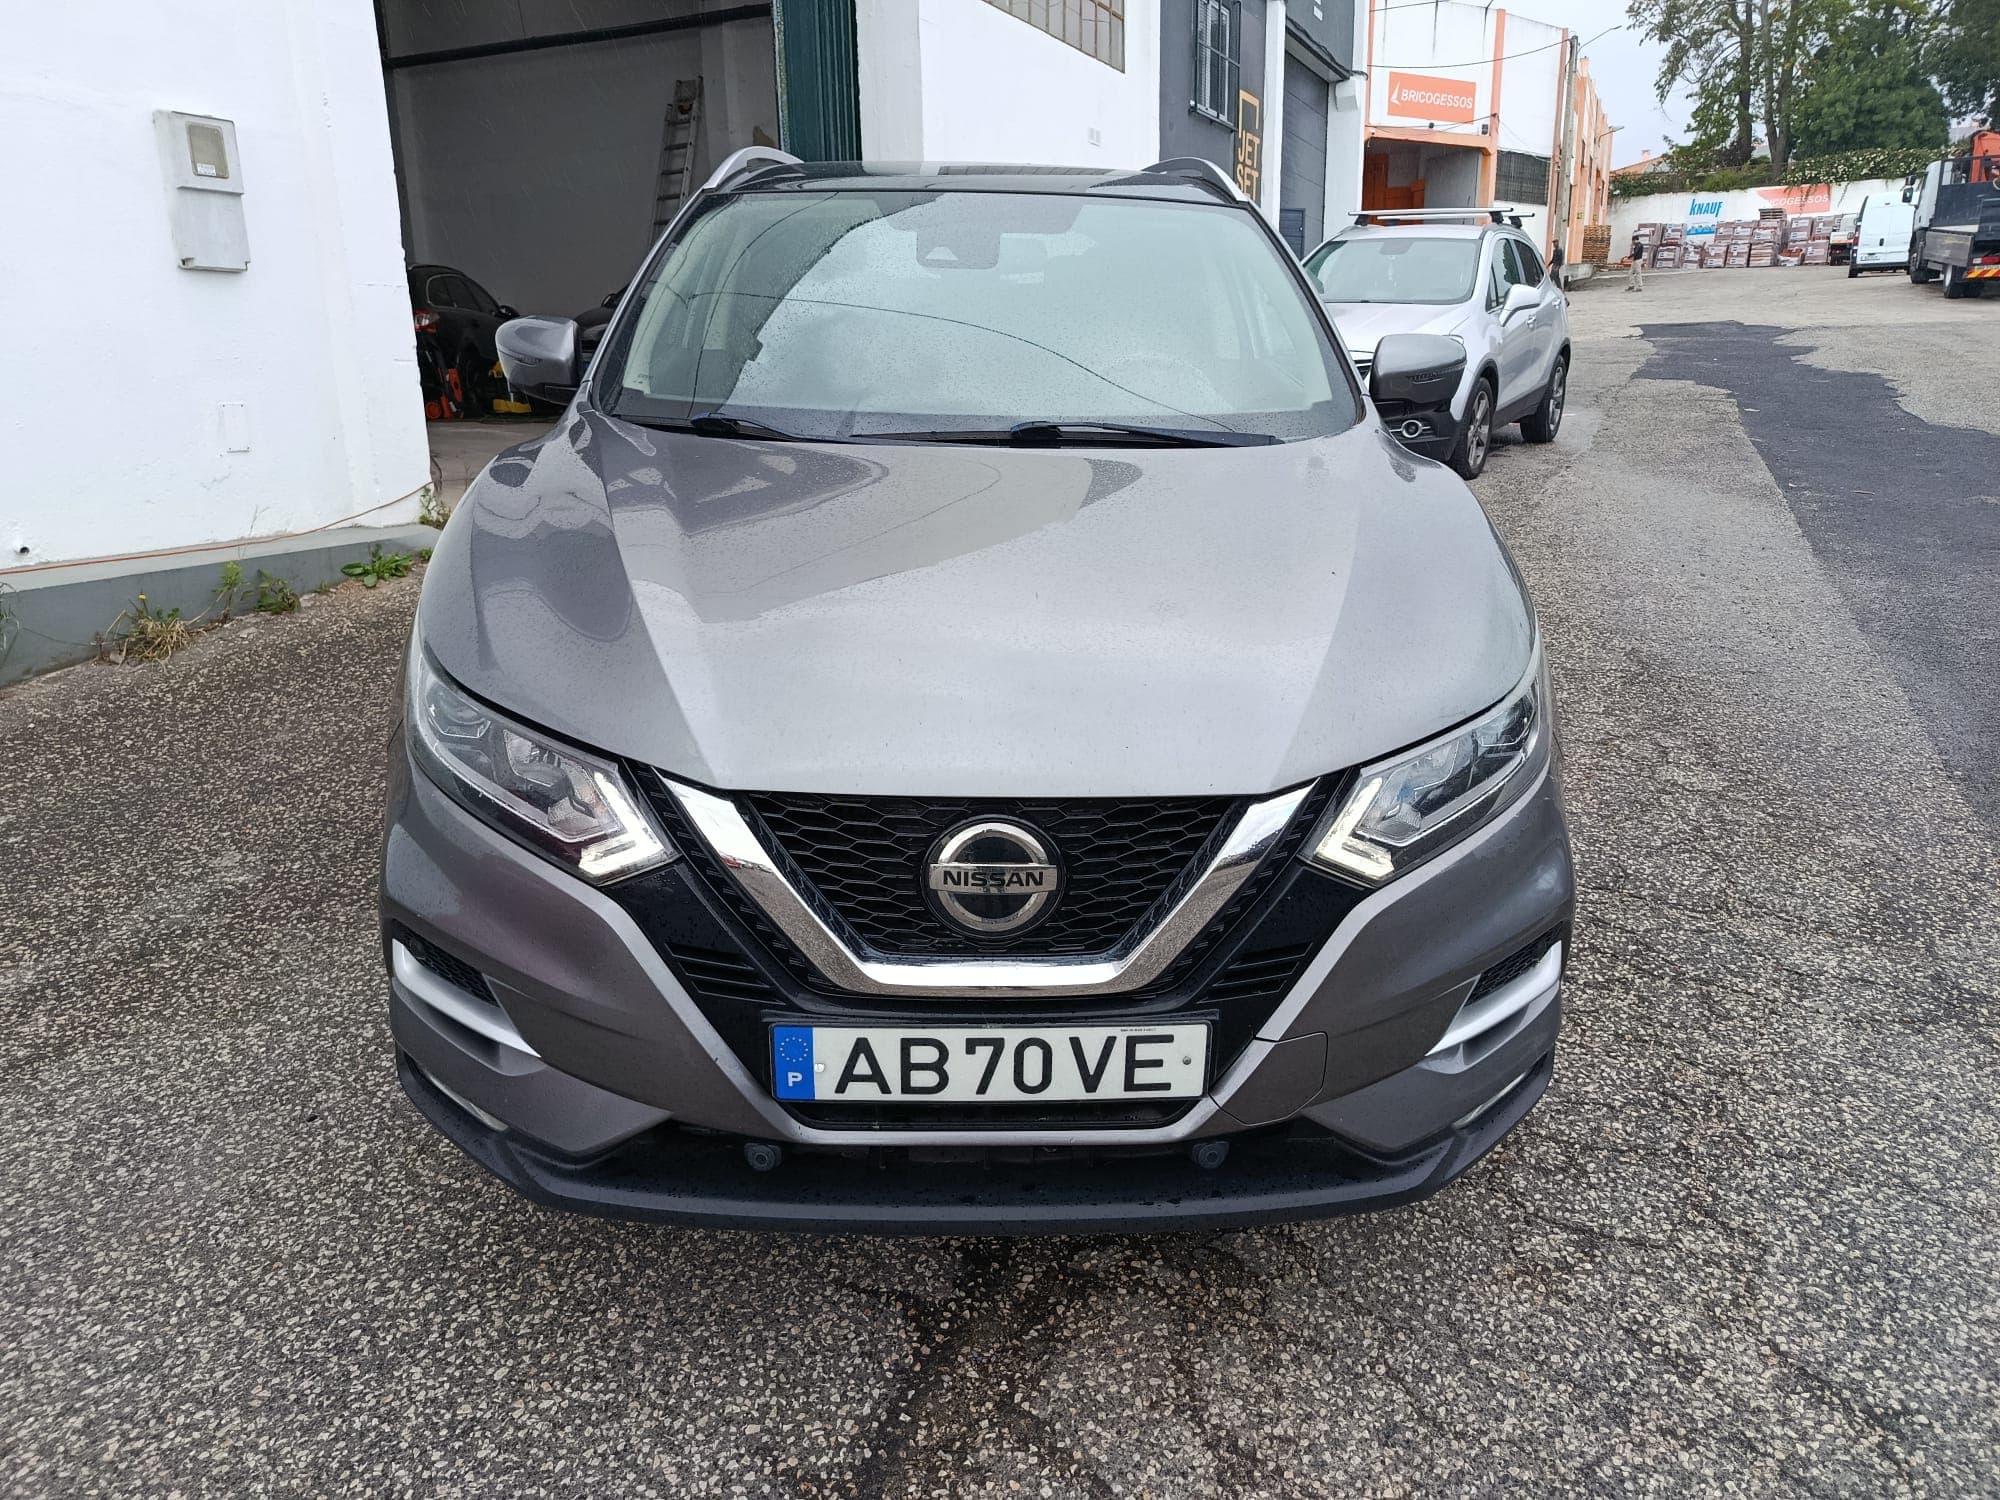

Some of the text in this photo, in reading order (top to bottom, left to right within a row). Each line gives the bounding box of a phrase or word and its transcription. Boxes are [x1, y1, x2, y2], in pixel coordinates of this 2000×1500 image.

[1401, 89, 1473, 109] BRICOGESSOS
[1238, 130, 1260, 169] JET
[1236, 163, 1259, 201] SET
[943, 870, 1044, 887] NISSAN
[787, 1071, 803, 1087] P
